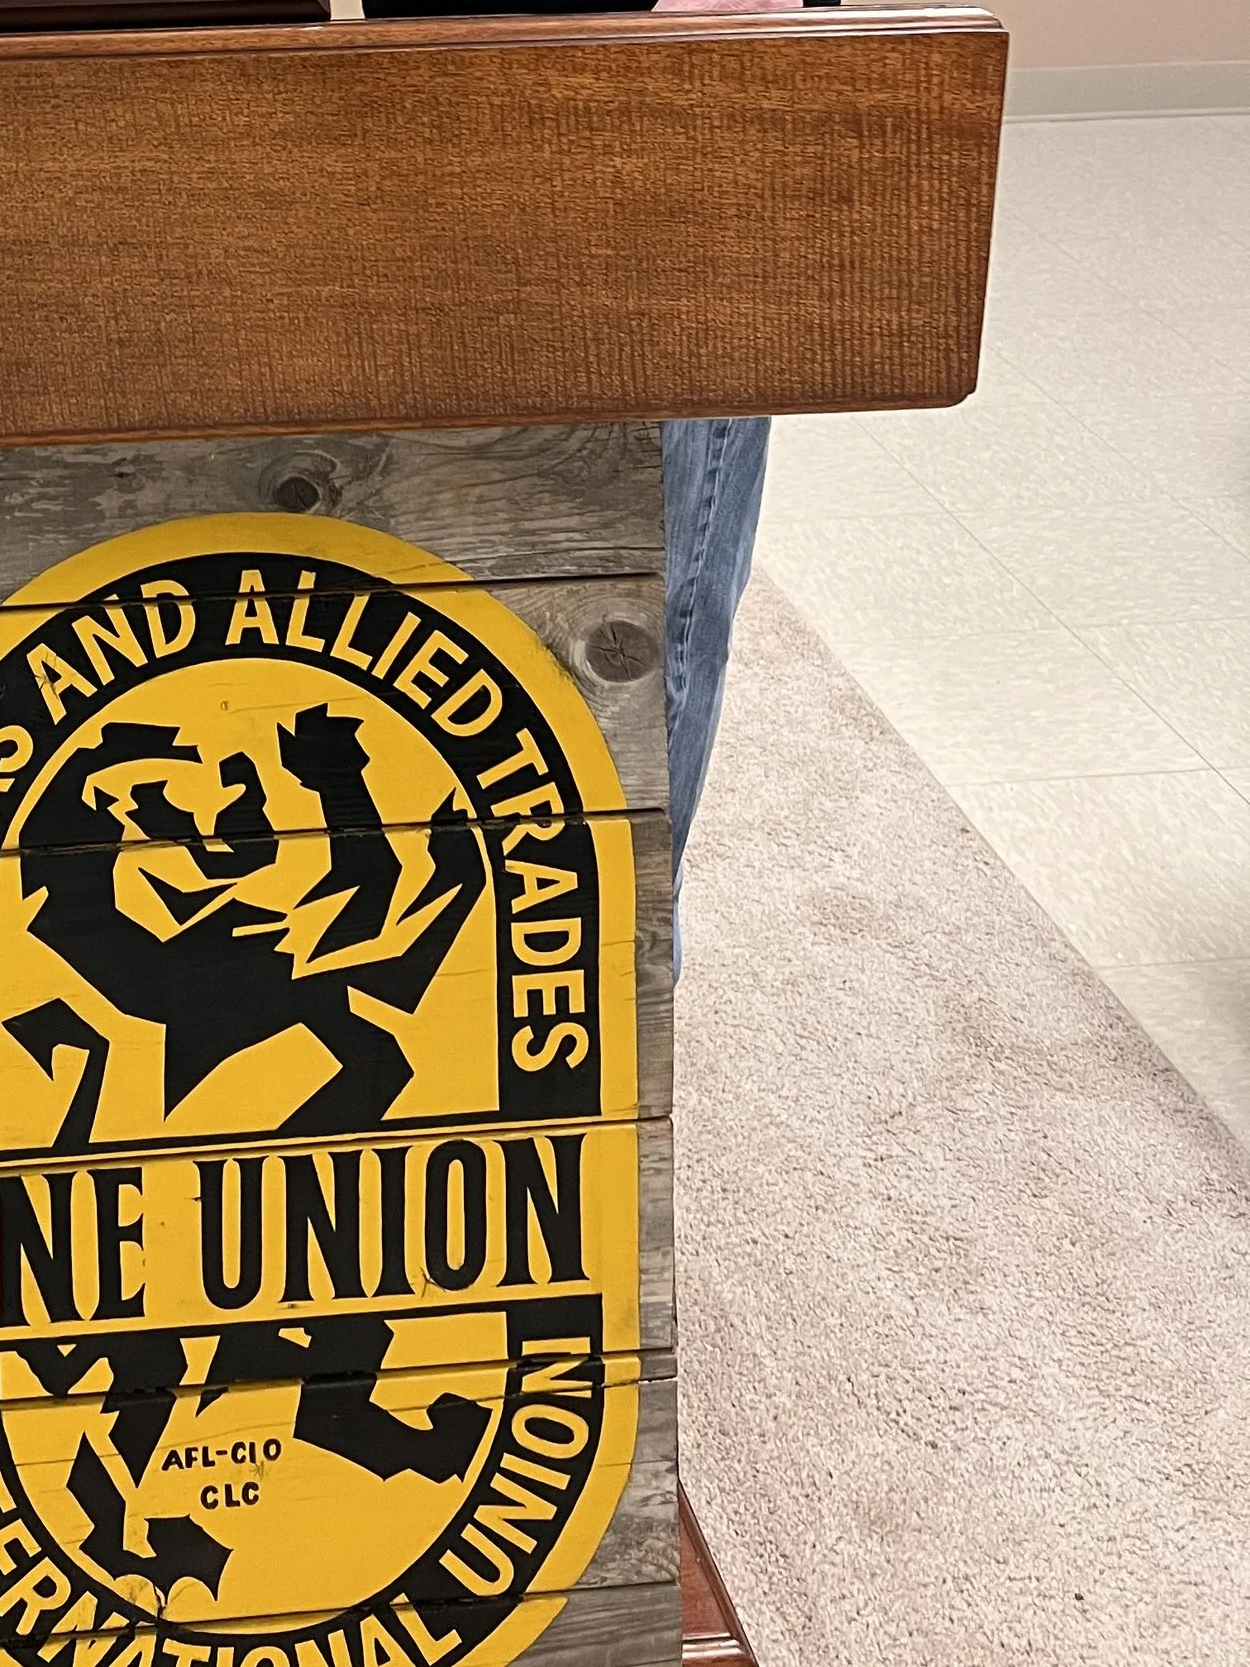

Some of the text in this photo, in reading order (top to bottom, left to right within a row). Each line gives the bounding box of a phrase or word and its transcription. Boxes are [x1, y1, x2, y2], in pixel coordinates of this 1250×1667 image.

[26, 579, 196, 725] AND
[225, 571, 503, 738] ALLIED
[476, 728, 591, 1074] TRADES
[193, 1134, 591, 1310] UNION
[161, 1438, 282, 1471] AFL-CIO
[200, 1481, 260, 1510] CLC
[439, 1336, 592, 1598] UNION
